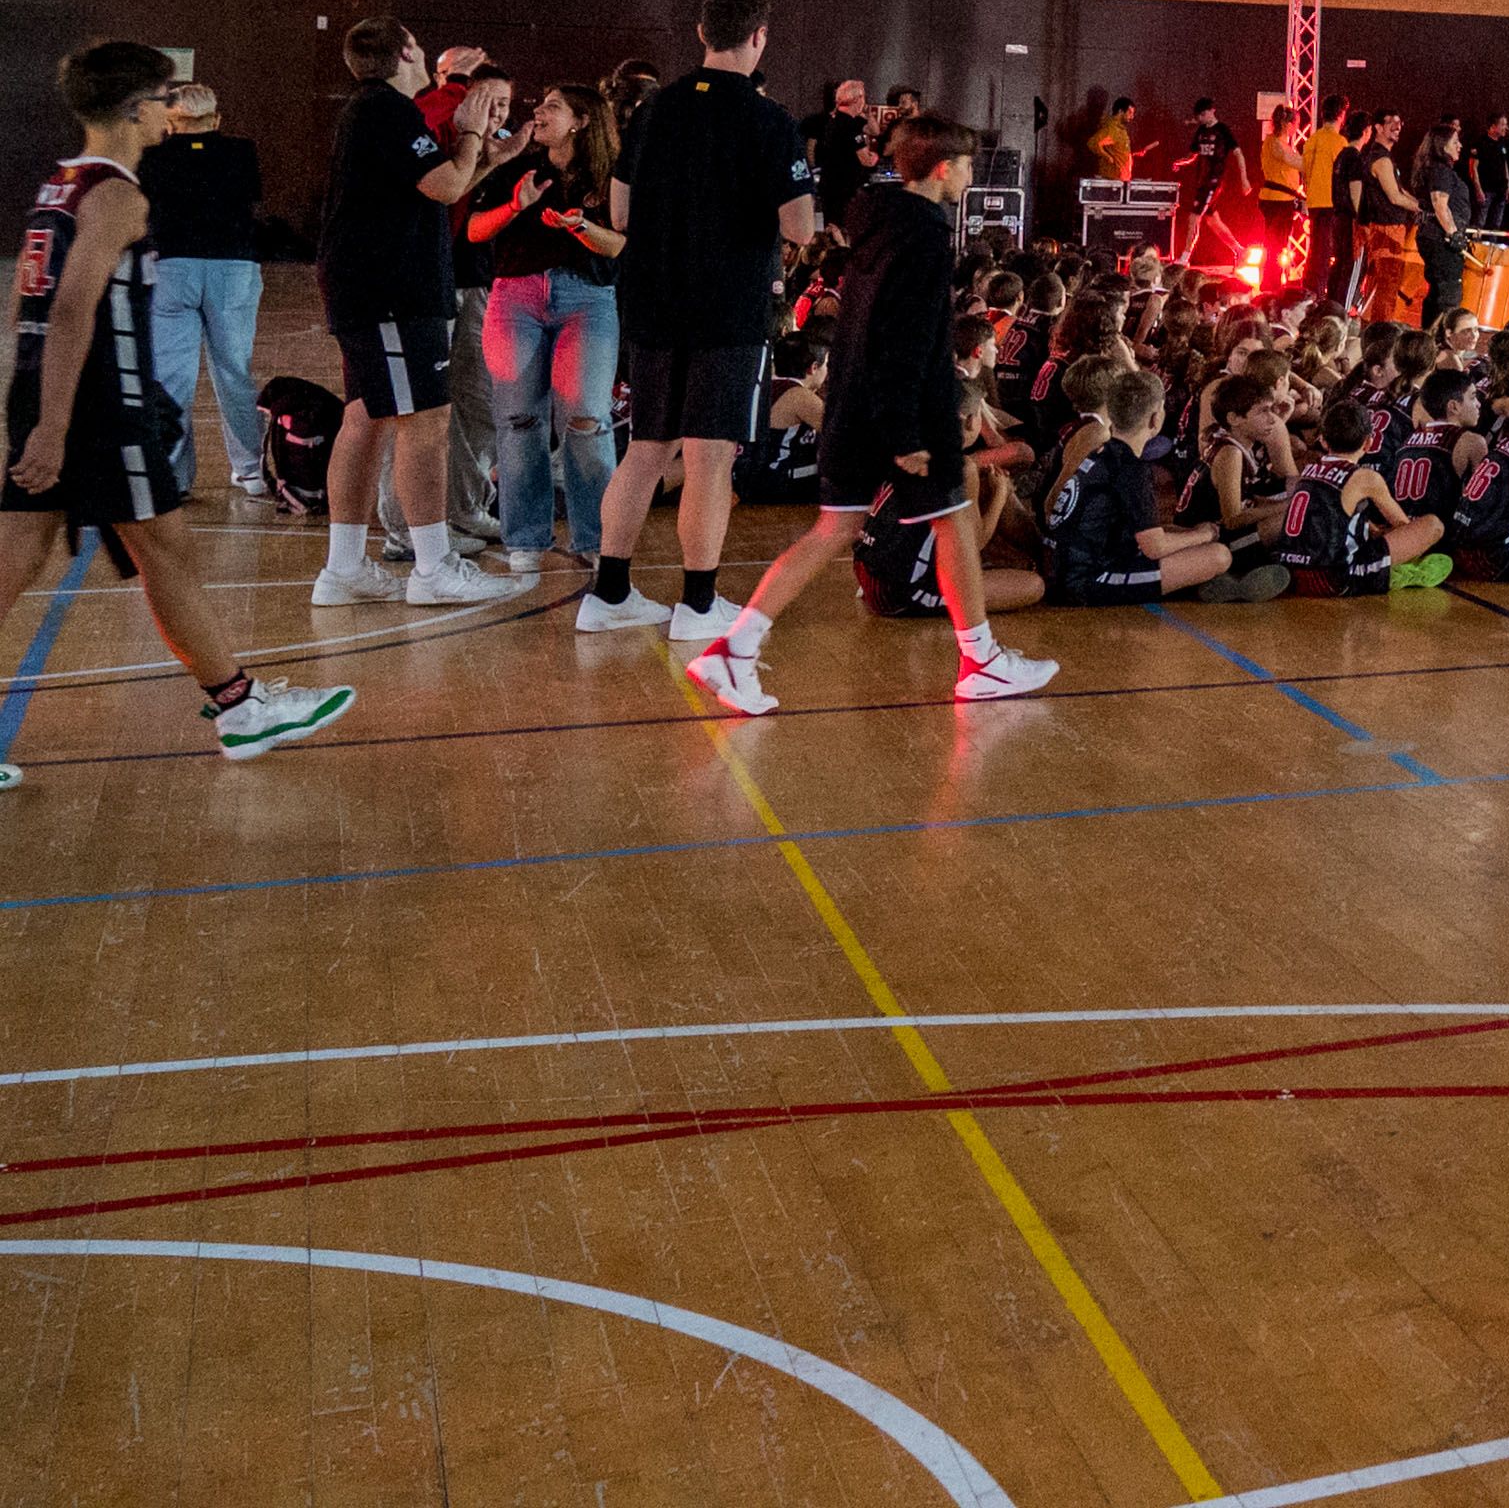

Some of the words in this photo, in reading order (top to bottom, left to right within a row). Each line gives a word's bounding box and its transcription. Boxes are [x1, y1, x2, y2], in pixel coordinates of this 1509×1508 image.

[1407, 432, 1444, 446] MARC
[1395, 457, 1432, 501] 00
[1285, 491, 1311, 537] 0
